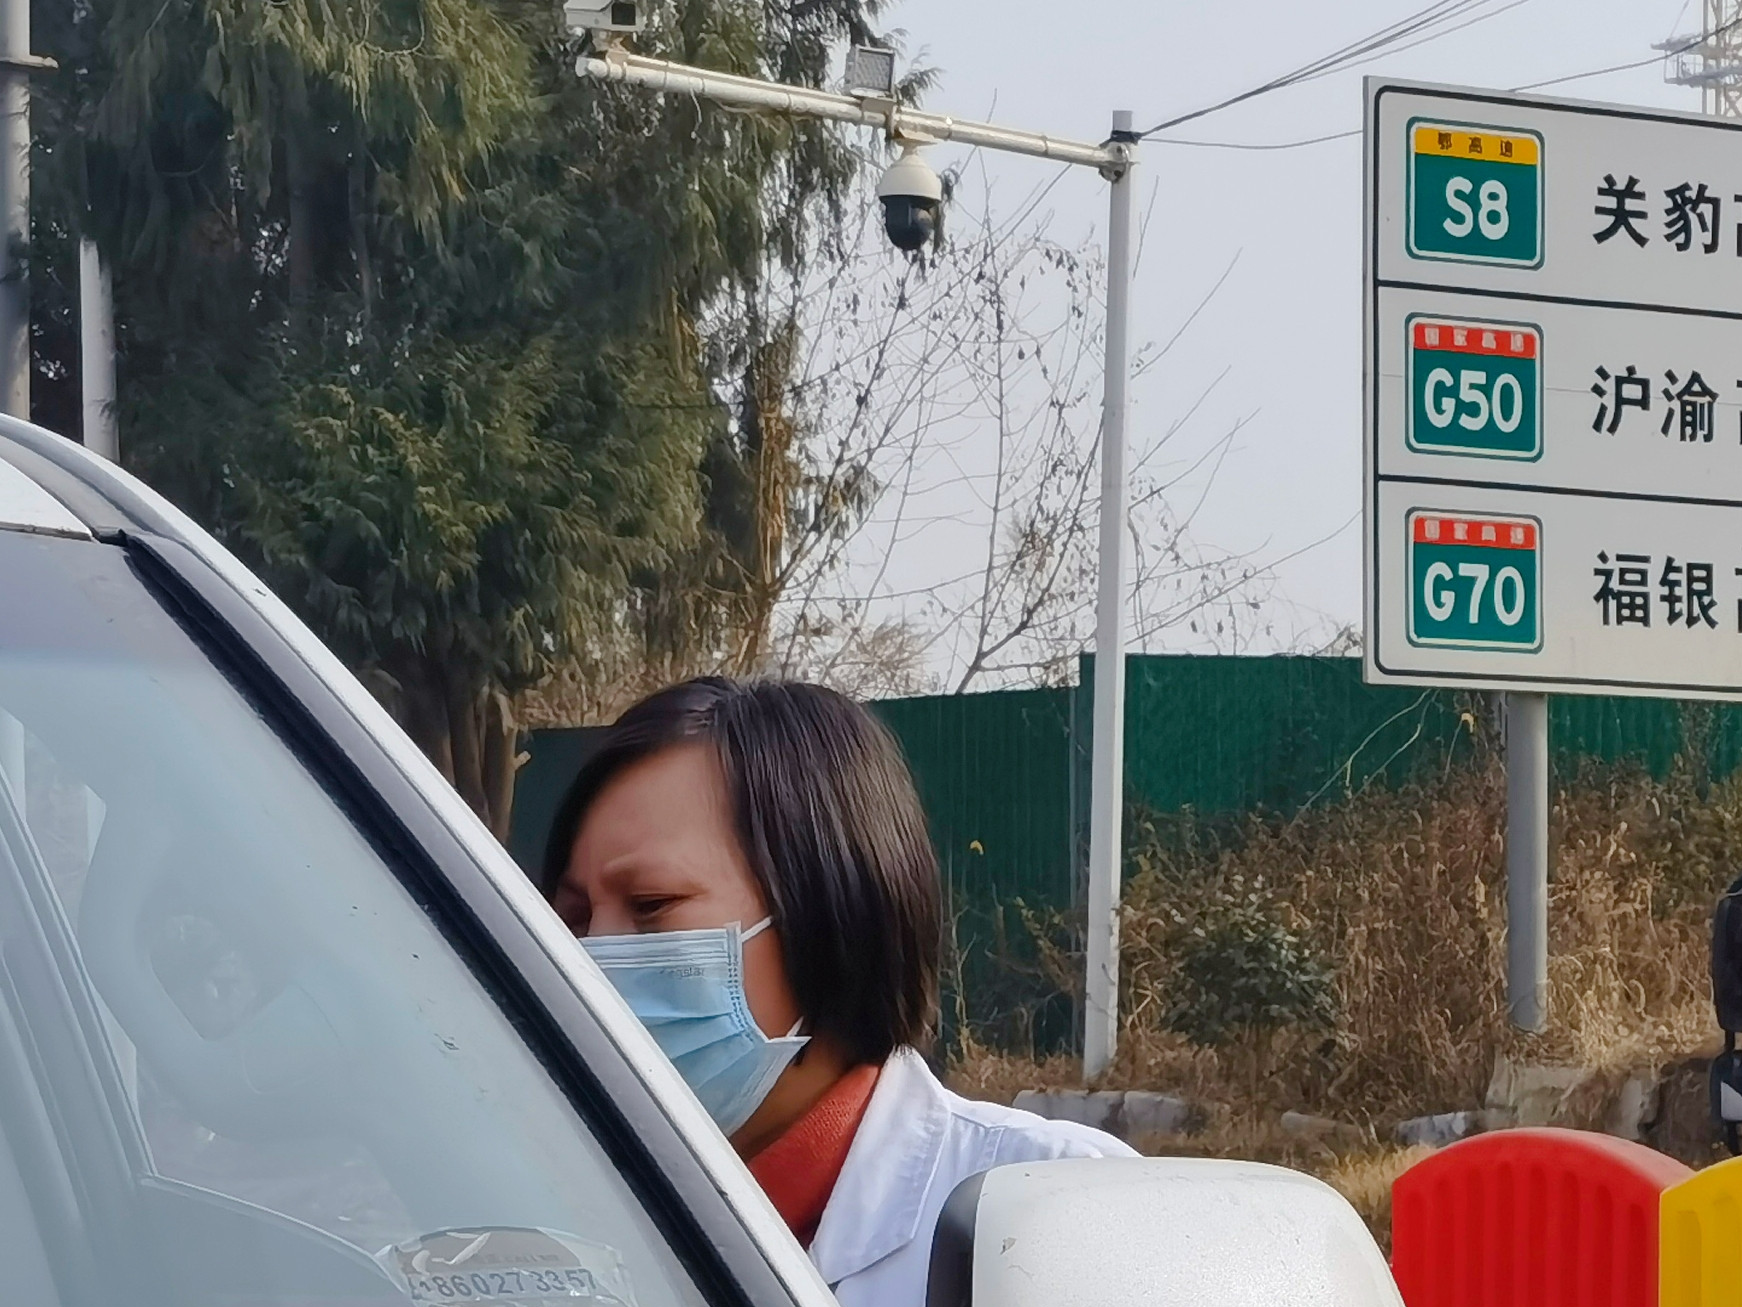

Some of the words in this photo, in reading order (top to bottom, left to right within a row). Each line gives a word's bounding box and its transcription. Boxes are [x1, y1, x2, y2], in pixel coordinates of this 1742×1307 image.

[1443, 176, 1510, 240] S8
[1424, 367, 1523, 433] G50
[1424, 561, 1525, 626] G70
